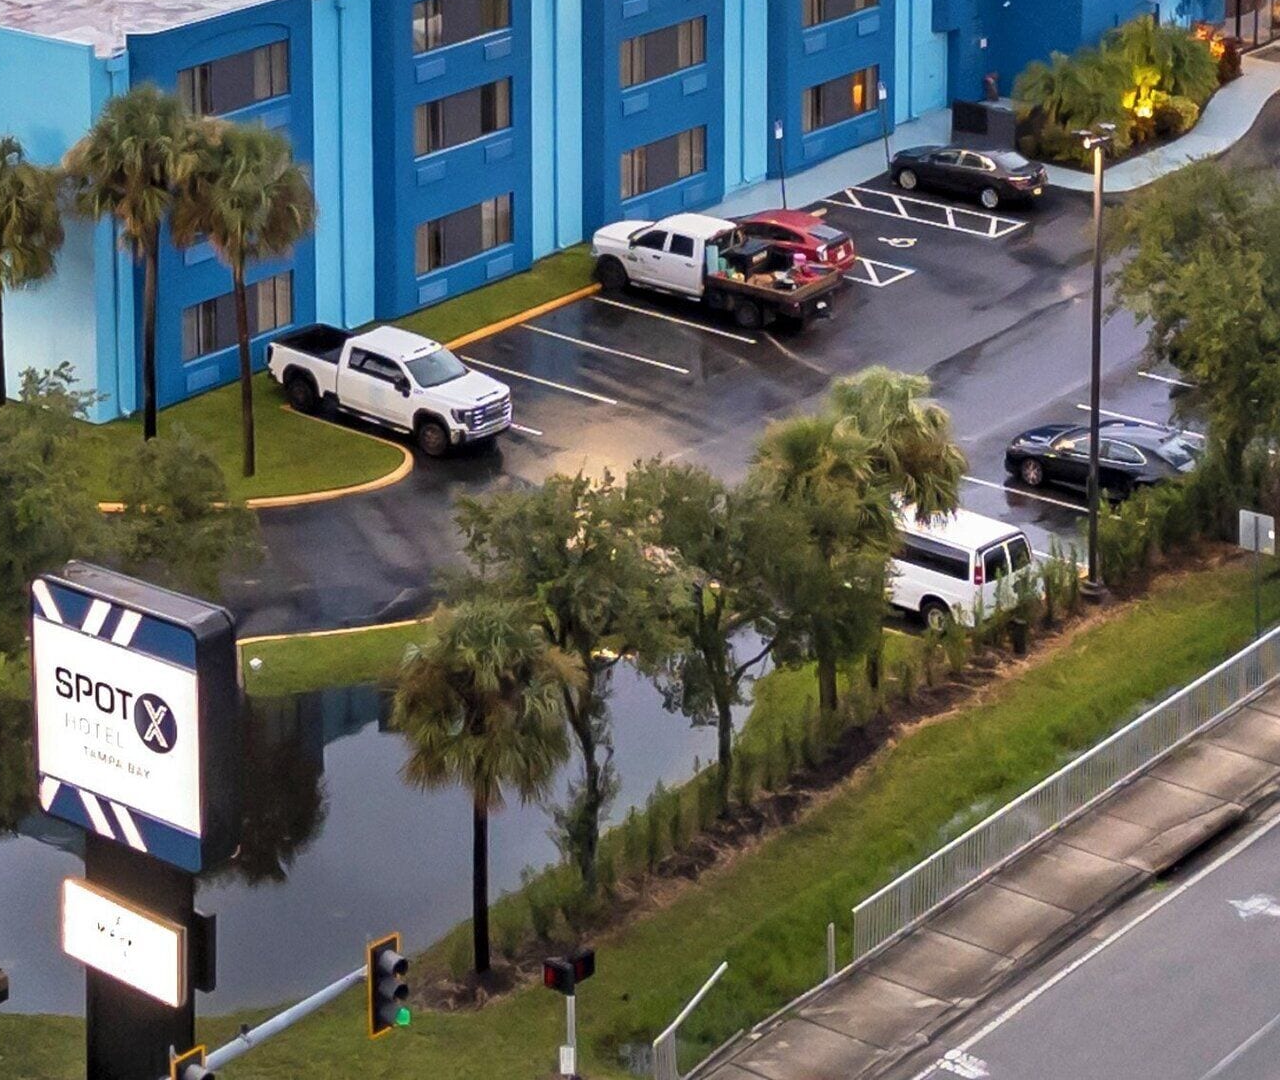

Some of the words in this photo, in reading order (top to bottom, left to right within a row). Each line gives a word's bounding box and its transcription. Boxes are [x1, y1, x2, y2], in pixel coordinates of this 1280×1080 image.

[55, 666, 133, 720] SPOT
[142, 699, 169, 749] X
[65, 712, 125, 749] HOTEL
[83, 745, 123, 769] TAMPA
[127, 762, 151, 779] BAY
